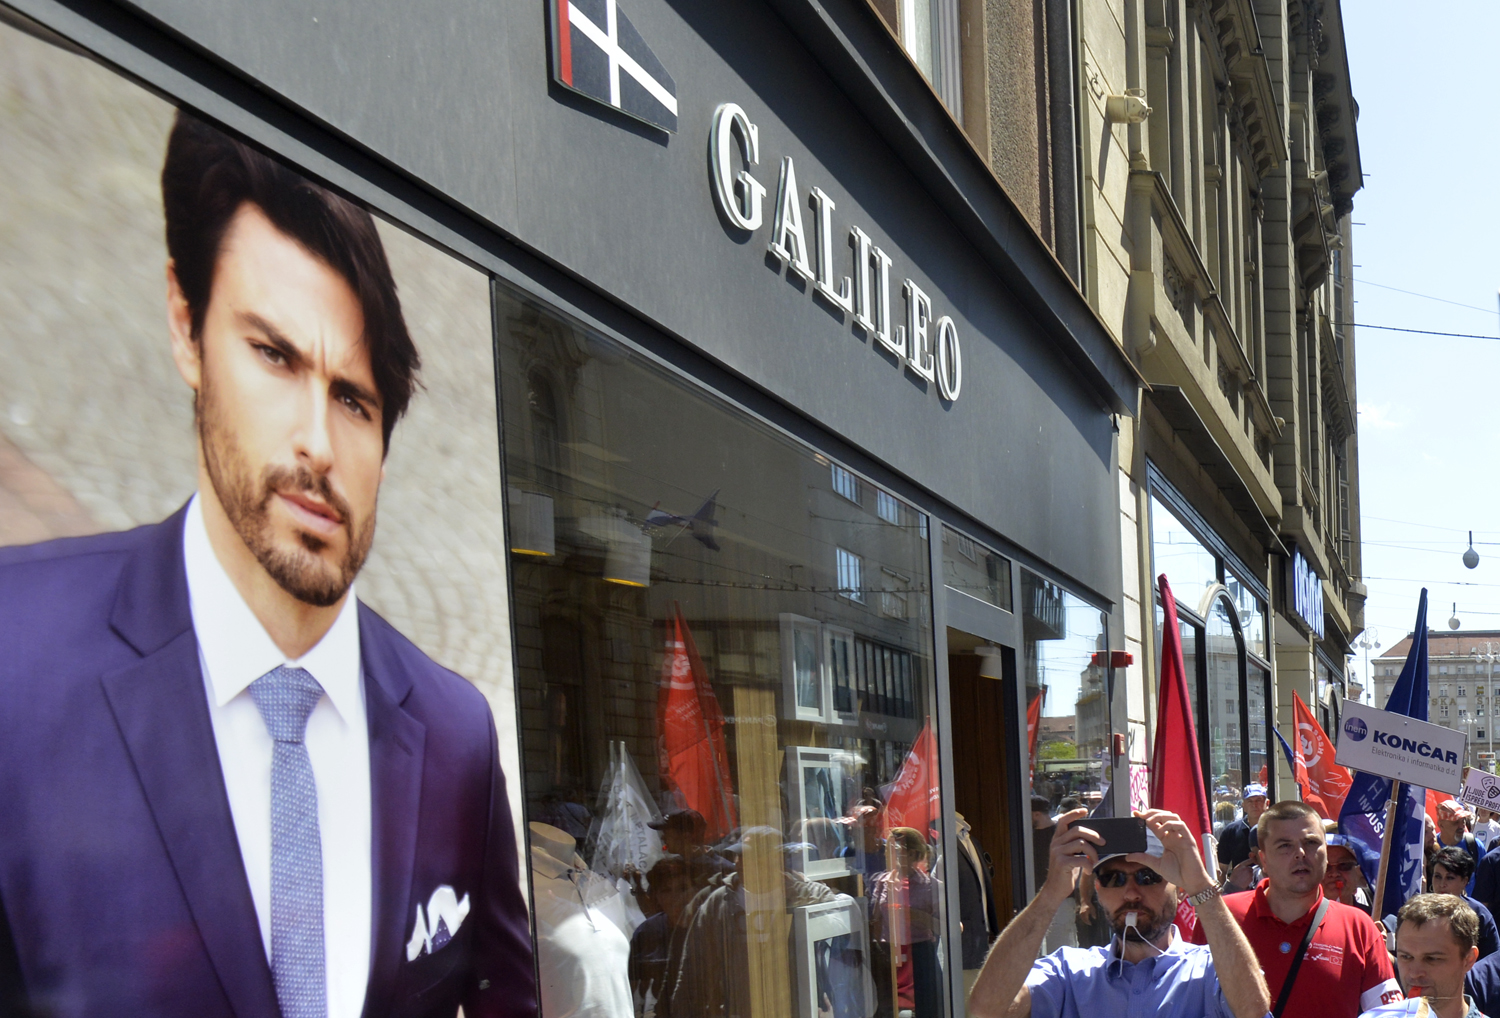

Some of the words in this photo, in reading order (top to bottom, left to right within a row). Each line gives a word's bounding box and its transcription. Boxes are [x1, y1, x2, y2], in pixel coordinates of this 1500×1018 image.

[708, 102, 963, 402] GALILEO
[1345, 721, 1368, 736] inem
[1373, 730, 1458, 765] KONČAR
[1371, 746, 1405, 763] Elektronika
[1410, 757, 1445, 773] informatika
[1465, 794, 1485, 806] ISPRED
[1468, 787, 1486, 798] LJUDE
